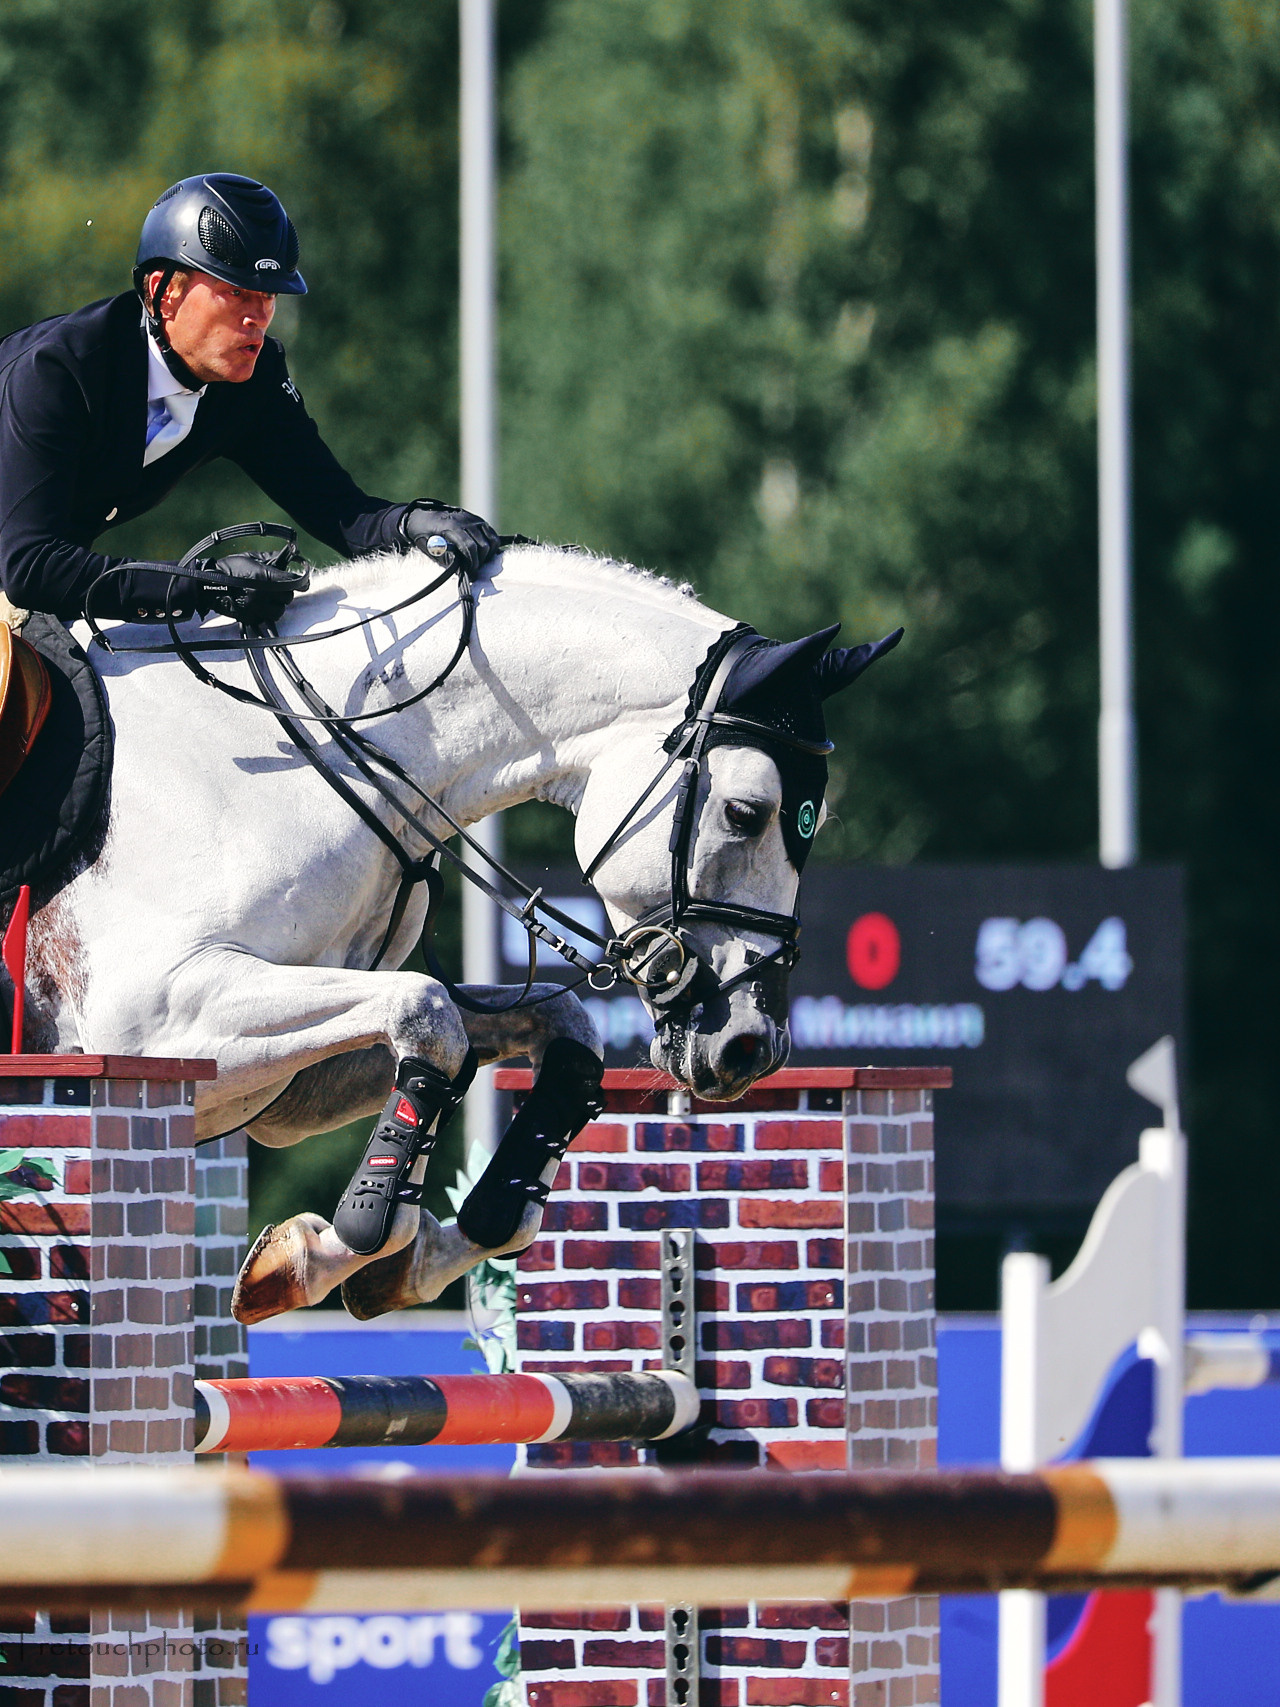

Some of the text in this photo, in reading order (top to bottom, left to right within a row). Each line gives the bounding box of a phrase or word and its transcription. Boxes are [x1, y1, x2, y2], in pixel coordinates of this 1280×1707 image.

[847, 911, 900, 990] 0
[975, 916, 1133, 991] 59.4
[266, 1613, 484, 1685] sport
